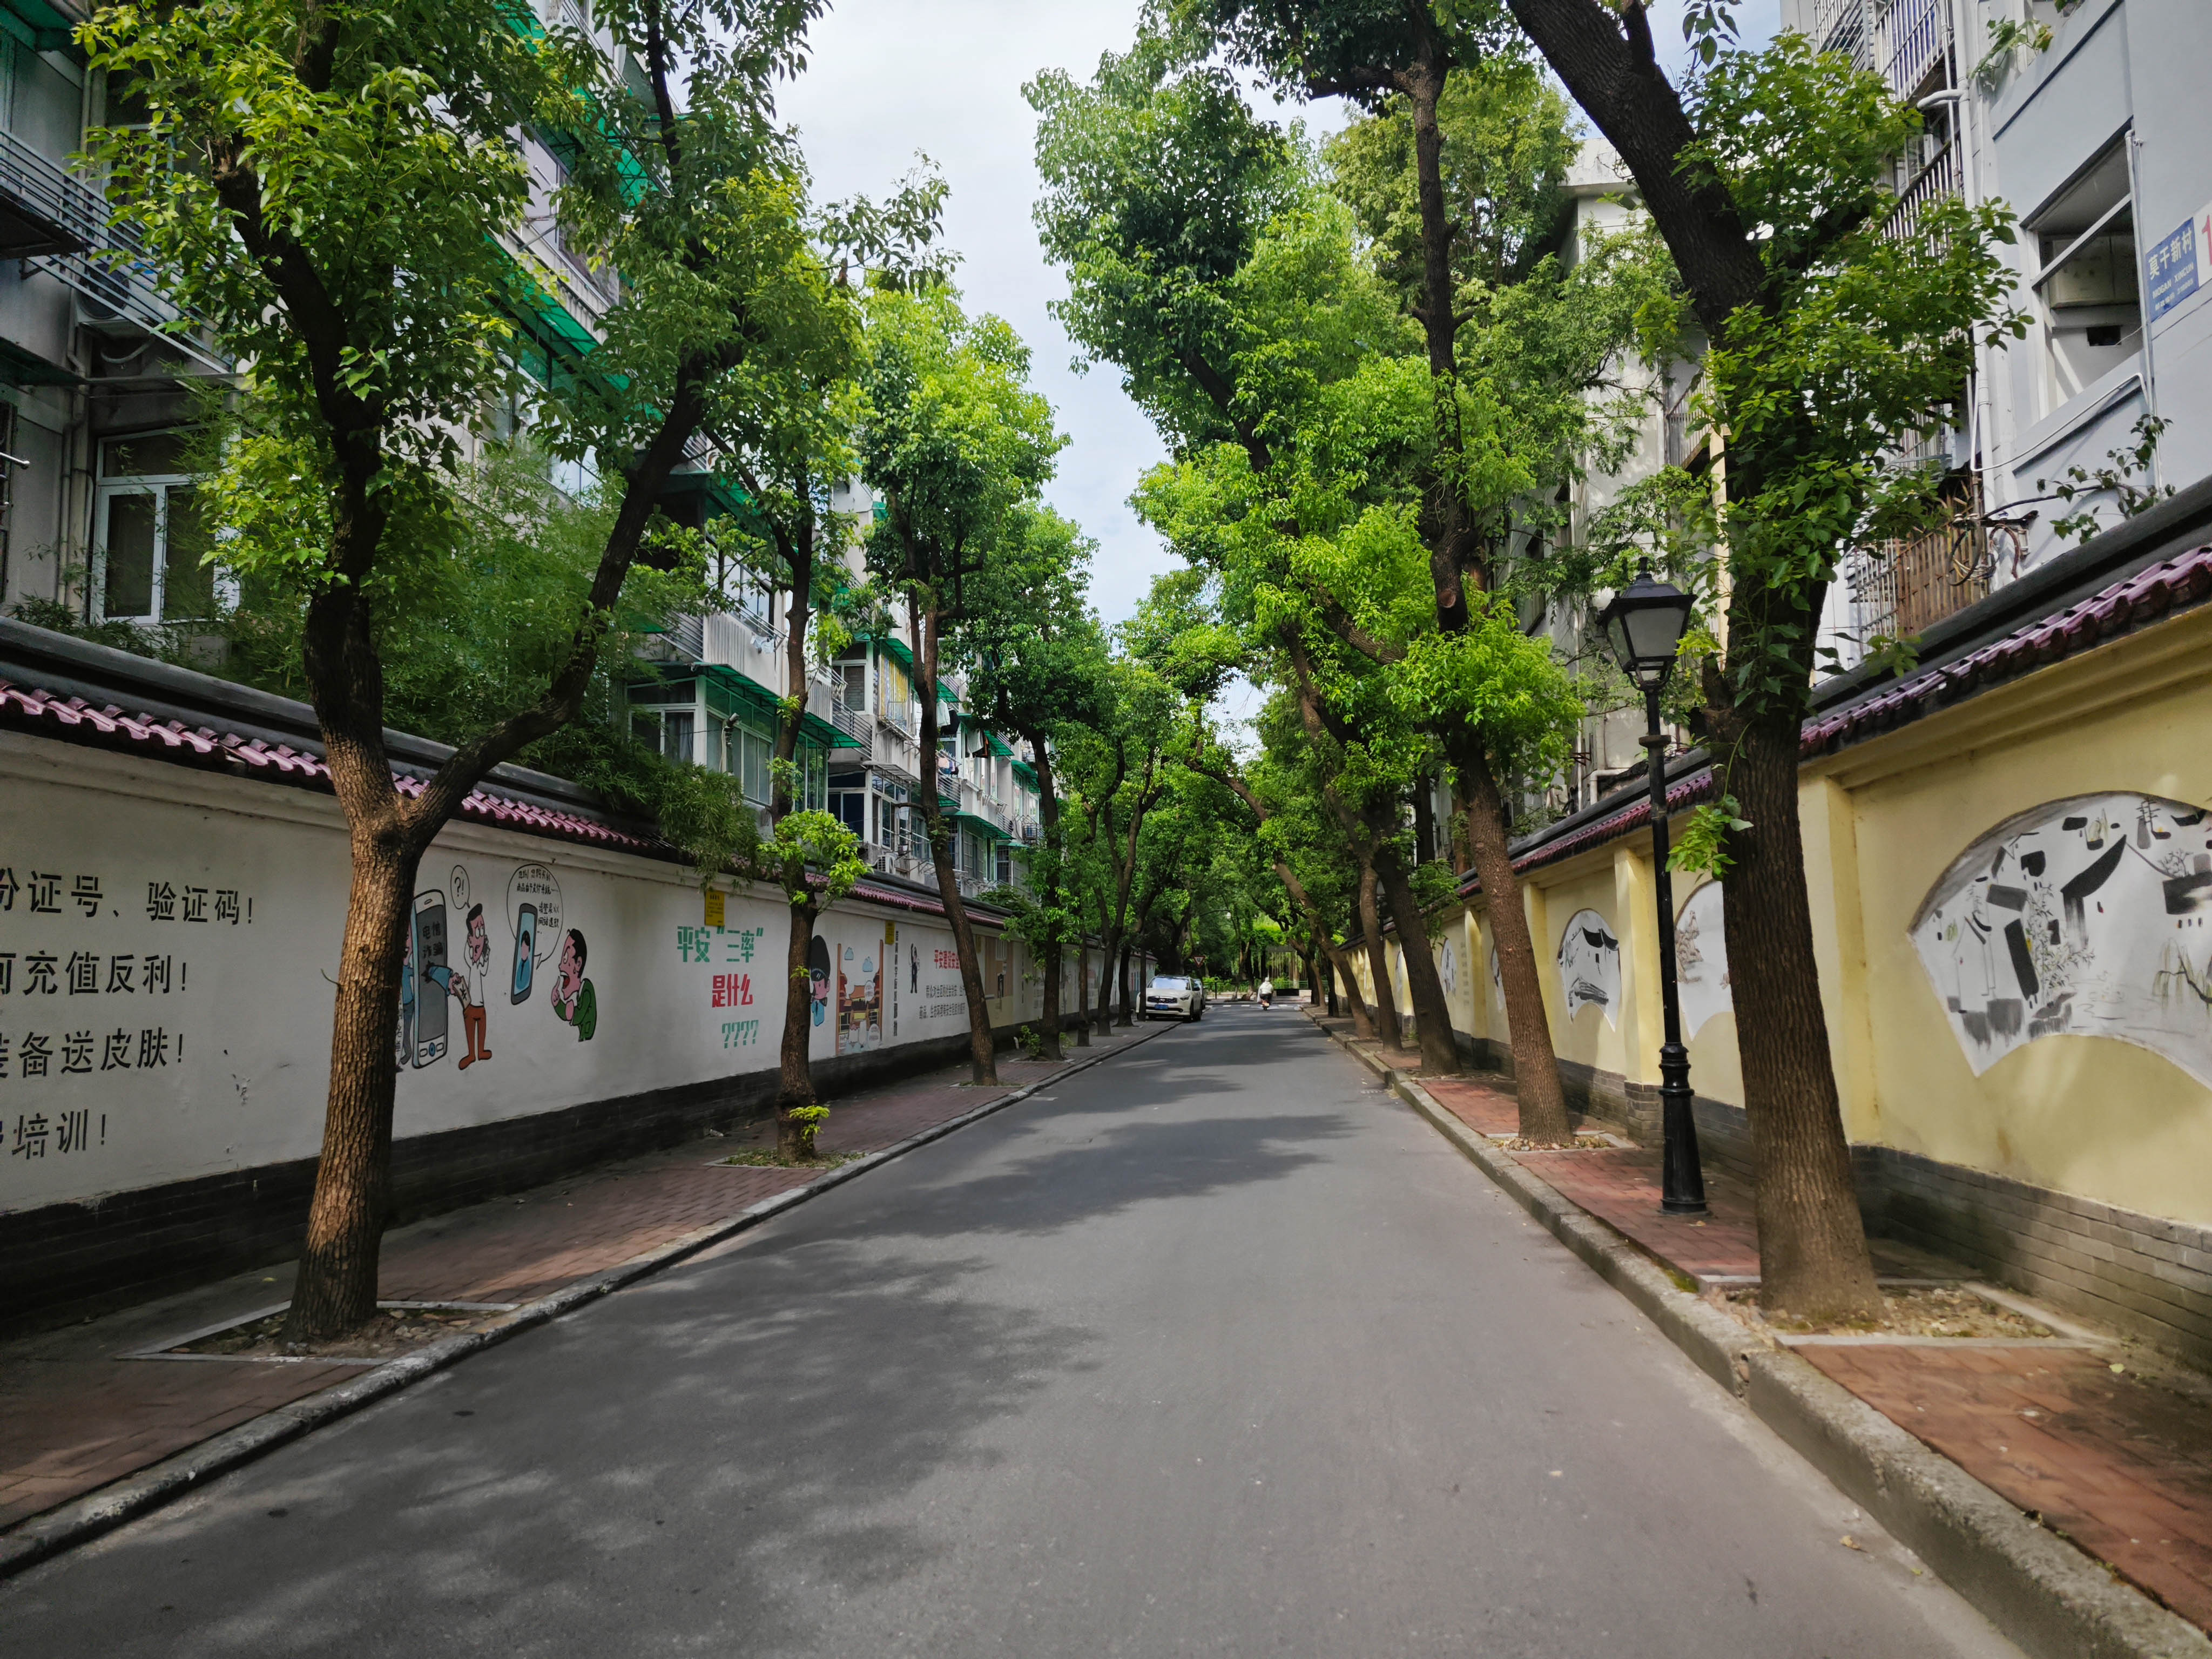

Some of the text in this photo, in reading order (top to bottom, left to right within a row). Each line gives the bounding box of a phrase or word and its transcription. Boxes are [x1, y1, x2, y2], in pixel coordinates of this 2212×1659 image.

[2148, 227, 2192, 280] 莫干新村
[2153, 262, 2194, 299] MOGAN XINCUN
[422, 920, 441, 939] 电信
[422, 941, 443, 959] 诈骗
[712, 974, 753, 1008] 是什么
[0, 1027, 183, 1078] 备送皮肤!
[0, 1109, 106, 1160] 培训!
